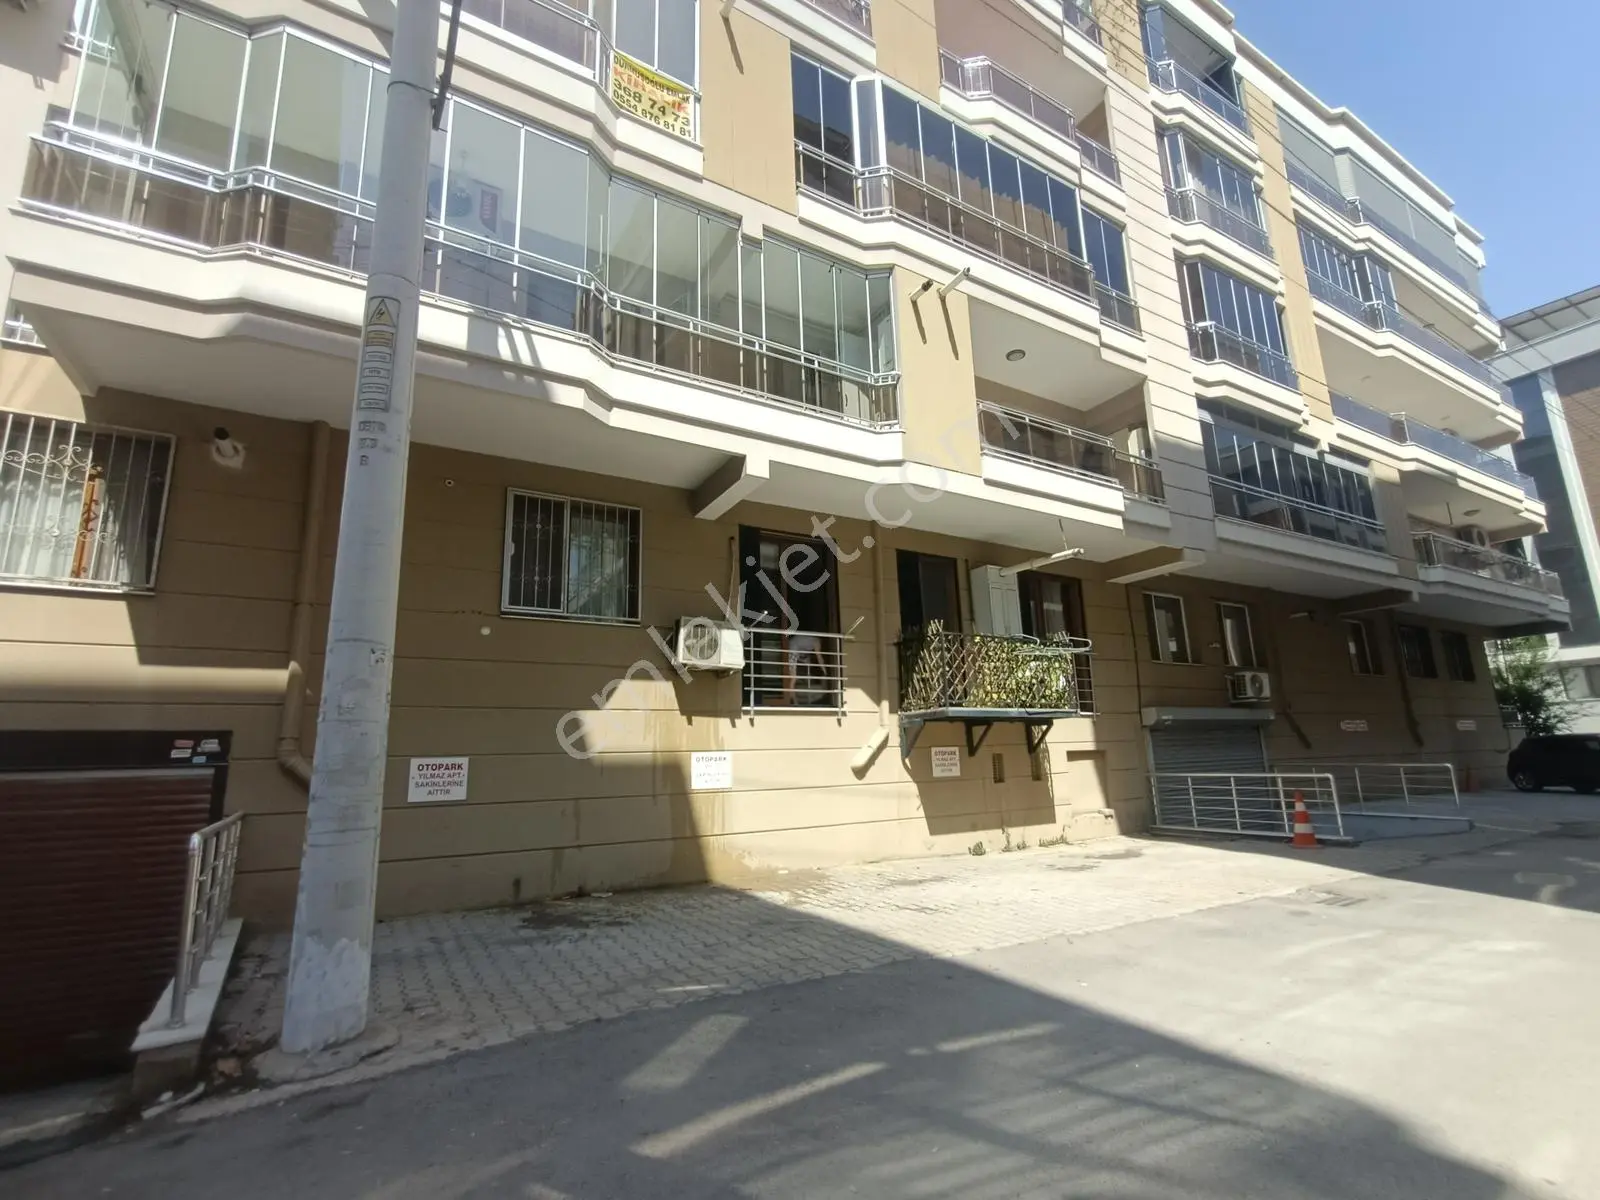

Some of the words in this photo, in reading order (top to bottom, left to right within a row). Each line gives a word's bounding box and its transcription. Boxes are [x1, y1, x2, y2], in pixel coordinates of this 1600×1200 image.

[613, 78, 643, 104] 368
[648, 97, 666, 116] 74
[671, 111, 690, 126] 73
[613, 89, 638, 112] 0554
[641, 109, 660, 125] 876
[663, 120, 677, 132] 81
[679, 126, 692, 138] 81
[417, 763, 464, 771] OTOPARK
